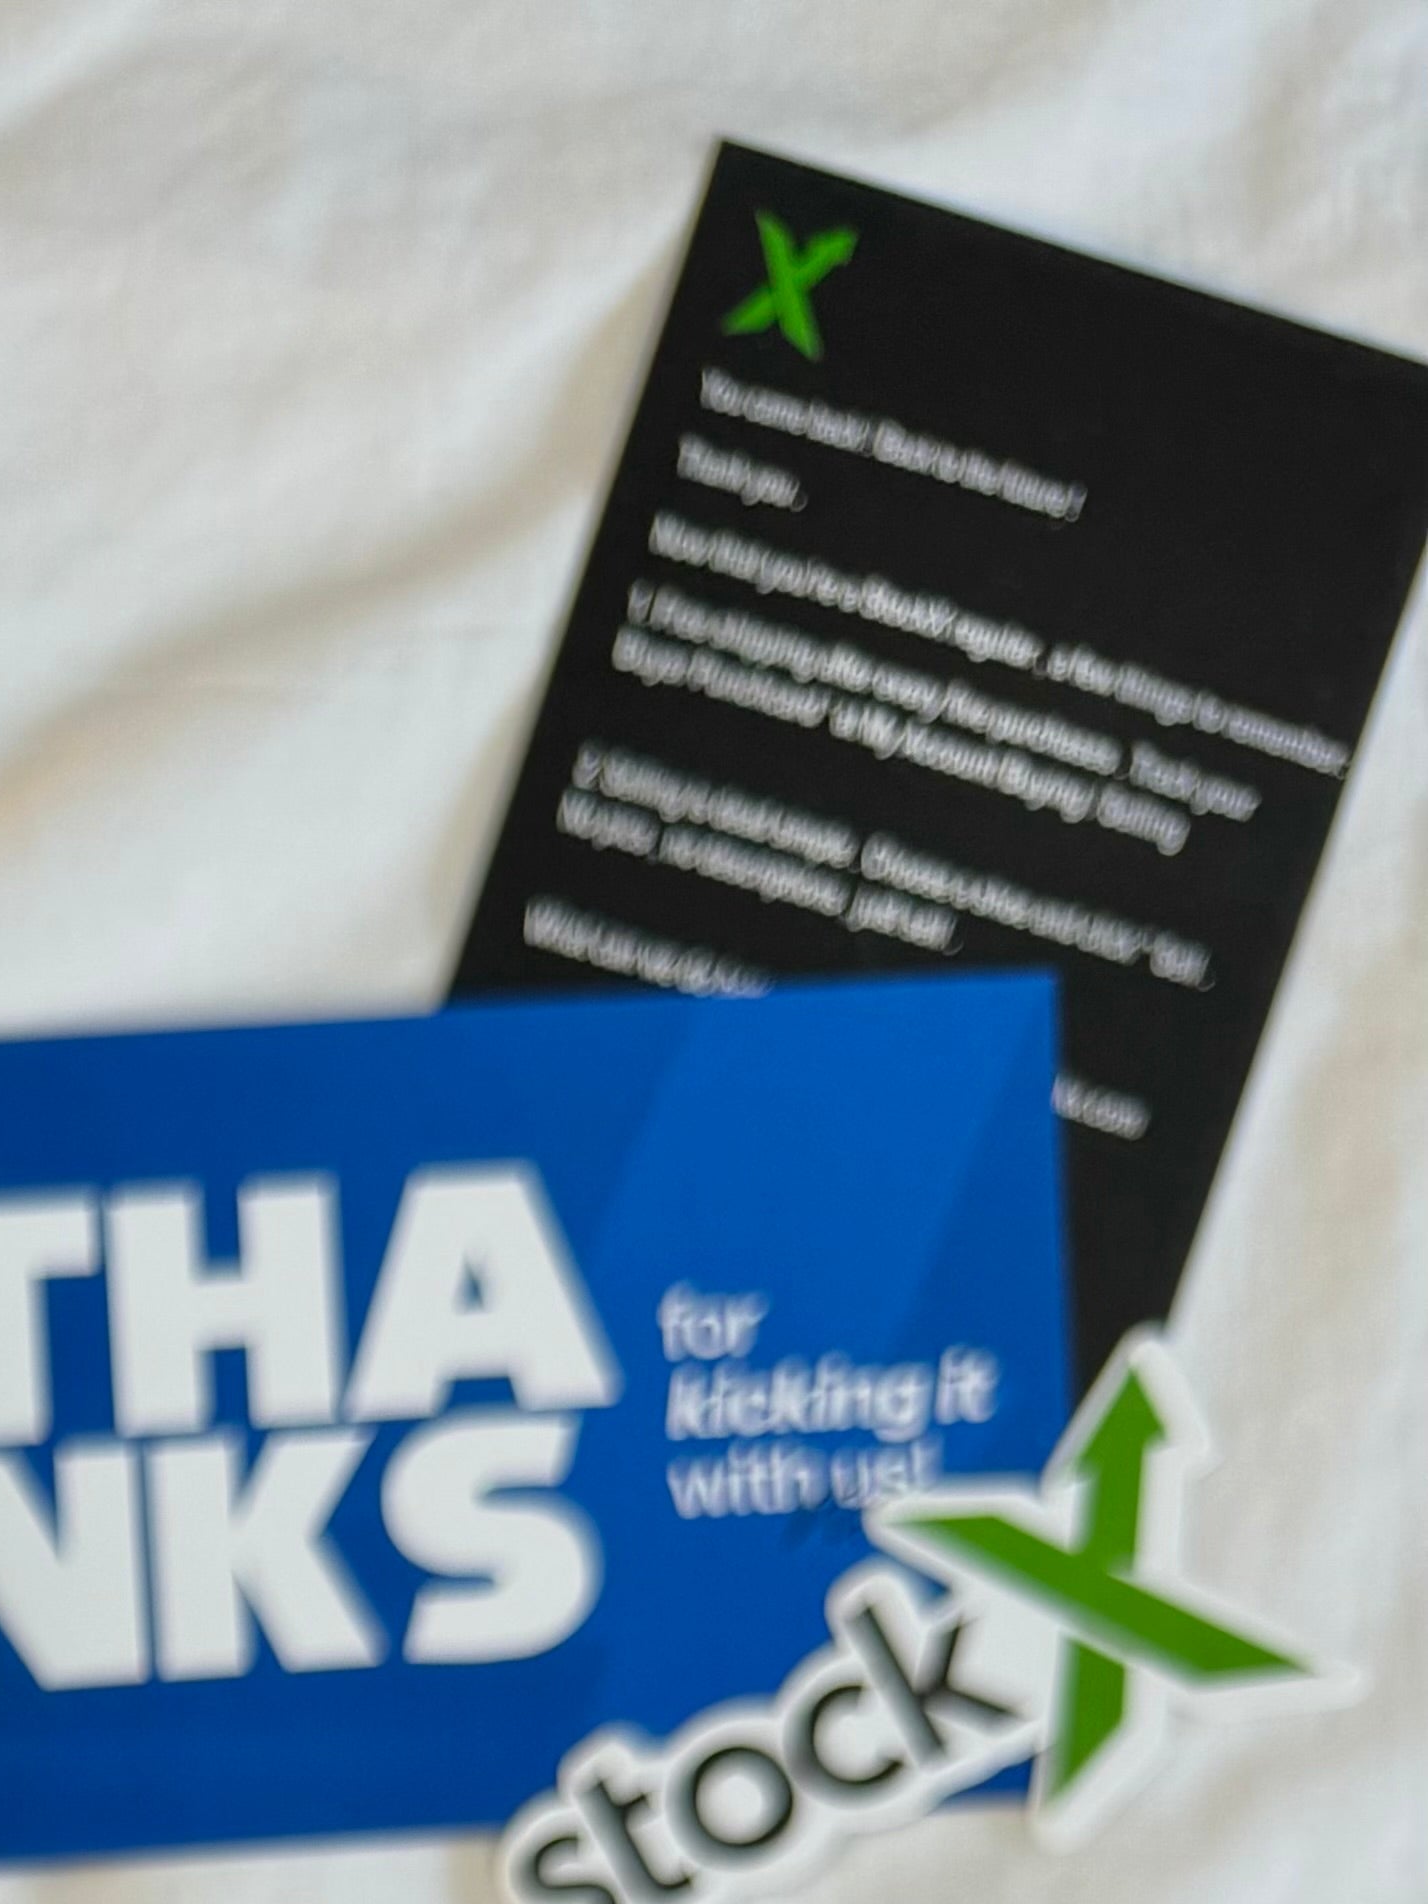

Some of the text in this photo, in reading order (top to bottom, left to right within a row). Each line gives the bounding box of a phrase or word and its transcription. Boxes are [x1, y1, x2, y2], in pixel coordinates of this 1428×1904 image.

[658, 1282, 766, 1362] for
[666, 1344, 999, 1442] kicking it
[667, 1440, 828, 1519] with
